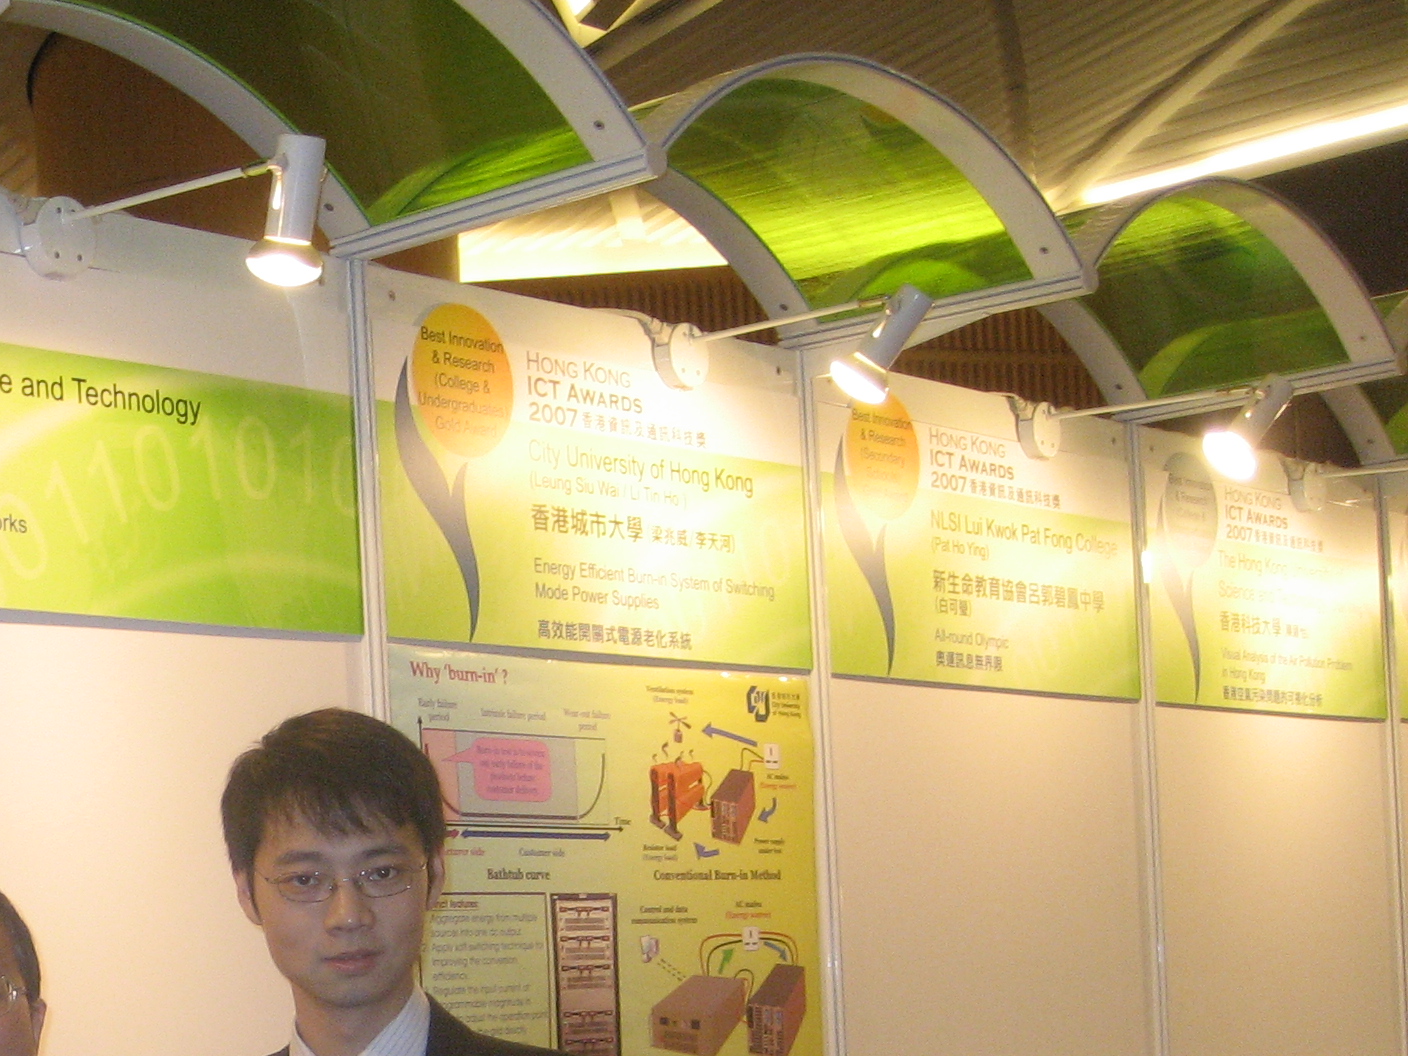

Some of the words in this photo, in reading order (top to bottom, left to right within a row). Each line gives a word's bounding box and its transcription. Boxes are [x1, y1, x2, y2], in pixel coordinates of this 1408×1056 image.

[420, 325, 446, 344] Best
[449, 331, 504, 354] Innovation
[431, 349, 440, 364] &
[443, 352, 495, 373] Research
[526, 350, 579, 379] HONG
[583, 361, 631, 388] KONG
[434, 372, 480, 394] (College
[483, 380, 490, 394] &
[527, 376, 560, 399] ICT
[567, 384, 643, 414] AWARDS
[21, 375, 64, 402] and
[71, 377, 201, 425] Technology
[529, 402, 578, 428] 2007
[929, 427, 968, 451] HONG
[971, 435, 1006, 458] KONG
[528, 439, 561, 470] City
[567, 444, 644, 482] University
[650, 459, 665, 479] of
[670, 461, 710, 492] Hong
[715, 467, 754, 498] Kong
[930, 449, 955, 469] ICT
[959, 455, 1015, 480] AWARDS
[530, 471, 572, 495] (Leung
[575, 476, 593, 494] Siu
[598, 481, 620, 497] Wai
[931, 471, 967, 493] 2007
[531, 504, 643, 542] 香港城市大學
[1225, 504, 1243, 522] ICT
[1247, 508, 1289, 529] AWARDS
[930, 510, 961, 532] NLSI
[964, 515, 983, 536] Lui
[986, 519, 1018, 541] Kwok
[1021, 524, 1041, 545] Pat
[1043, 528, 1073, 554] Fong
[1226, 523, 1253, 542] 2007
[534, 558, 576, 580] Energy
[579, 562, 625, 582] Efficient
[628, 568, 667, 586] Burn-in
[670, 572, 710, 592] System
[713, 578, 723, 593] of
[726, 579, 775, 602] Switching
[535, 582, 569, 601] Mode
[572, 586, 608, 605] Power
[612, 590, 660, 611] Supplies
[410, 660, 441, 684] Why
[614, 816, 632, 826] Time
[487, 868, 524, 881] Bathtub
[525, 870, 551, 881] curve
[653, 869, 713, 881] Conventional
[714, 869, 749, 881] Burn-in
[750, 869, 782, 881] Method
